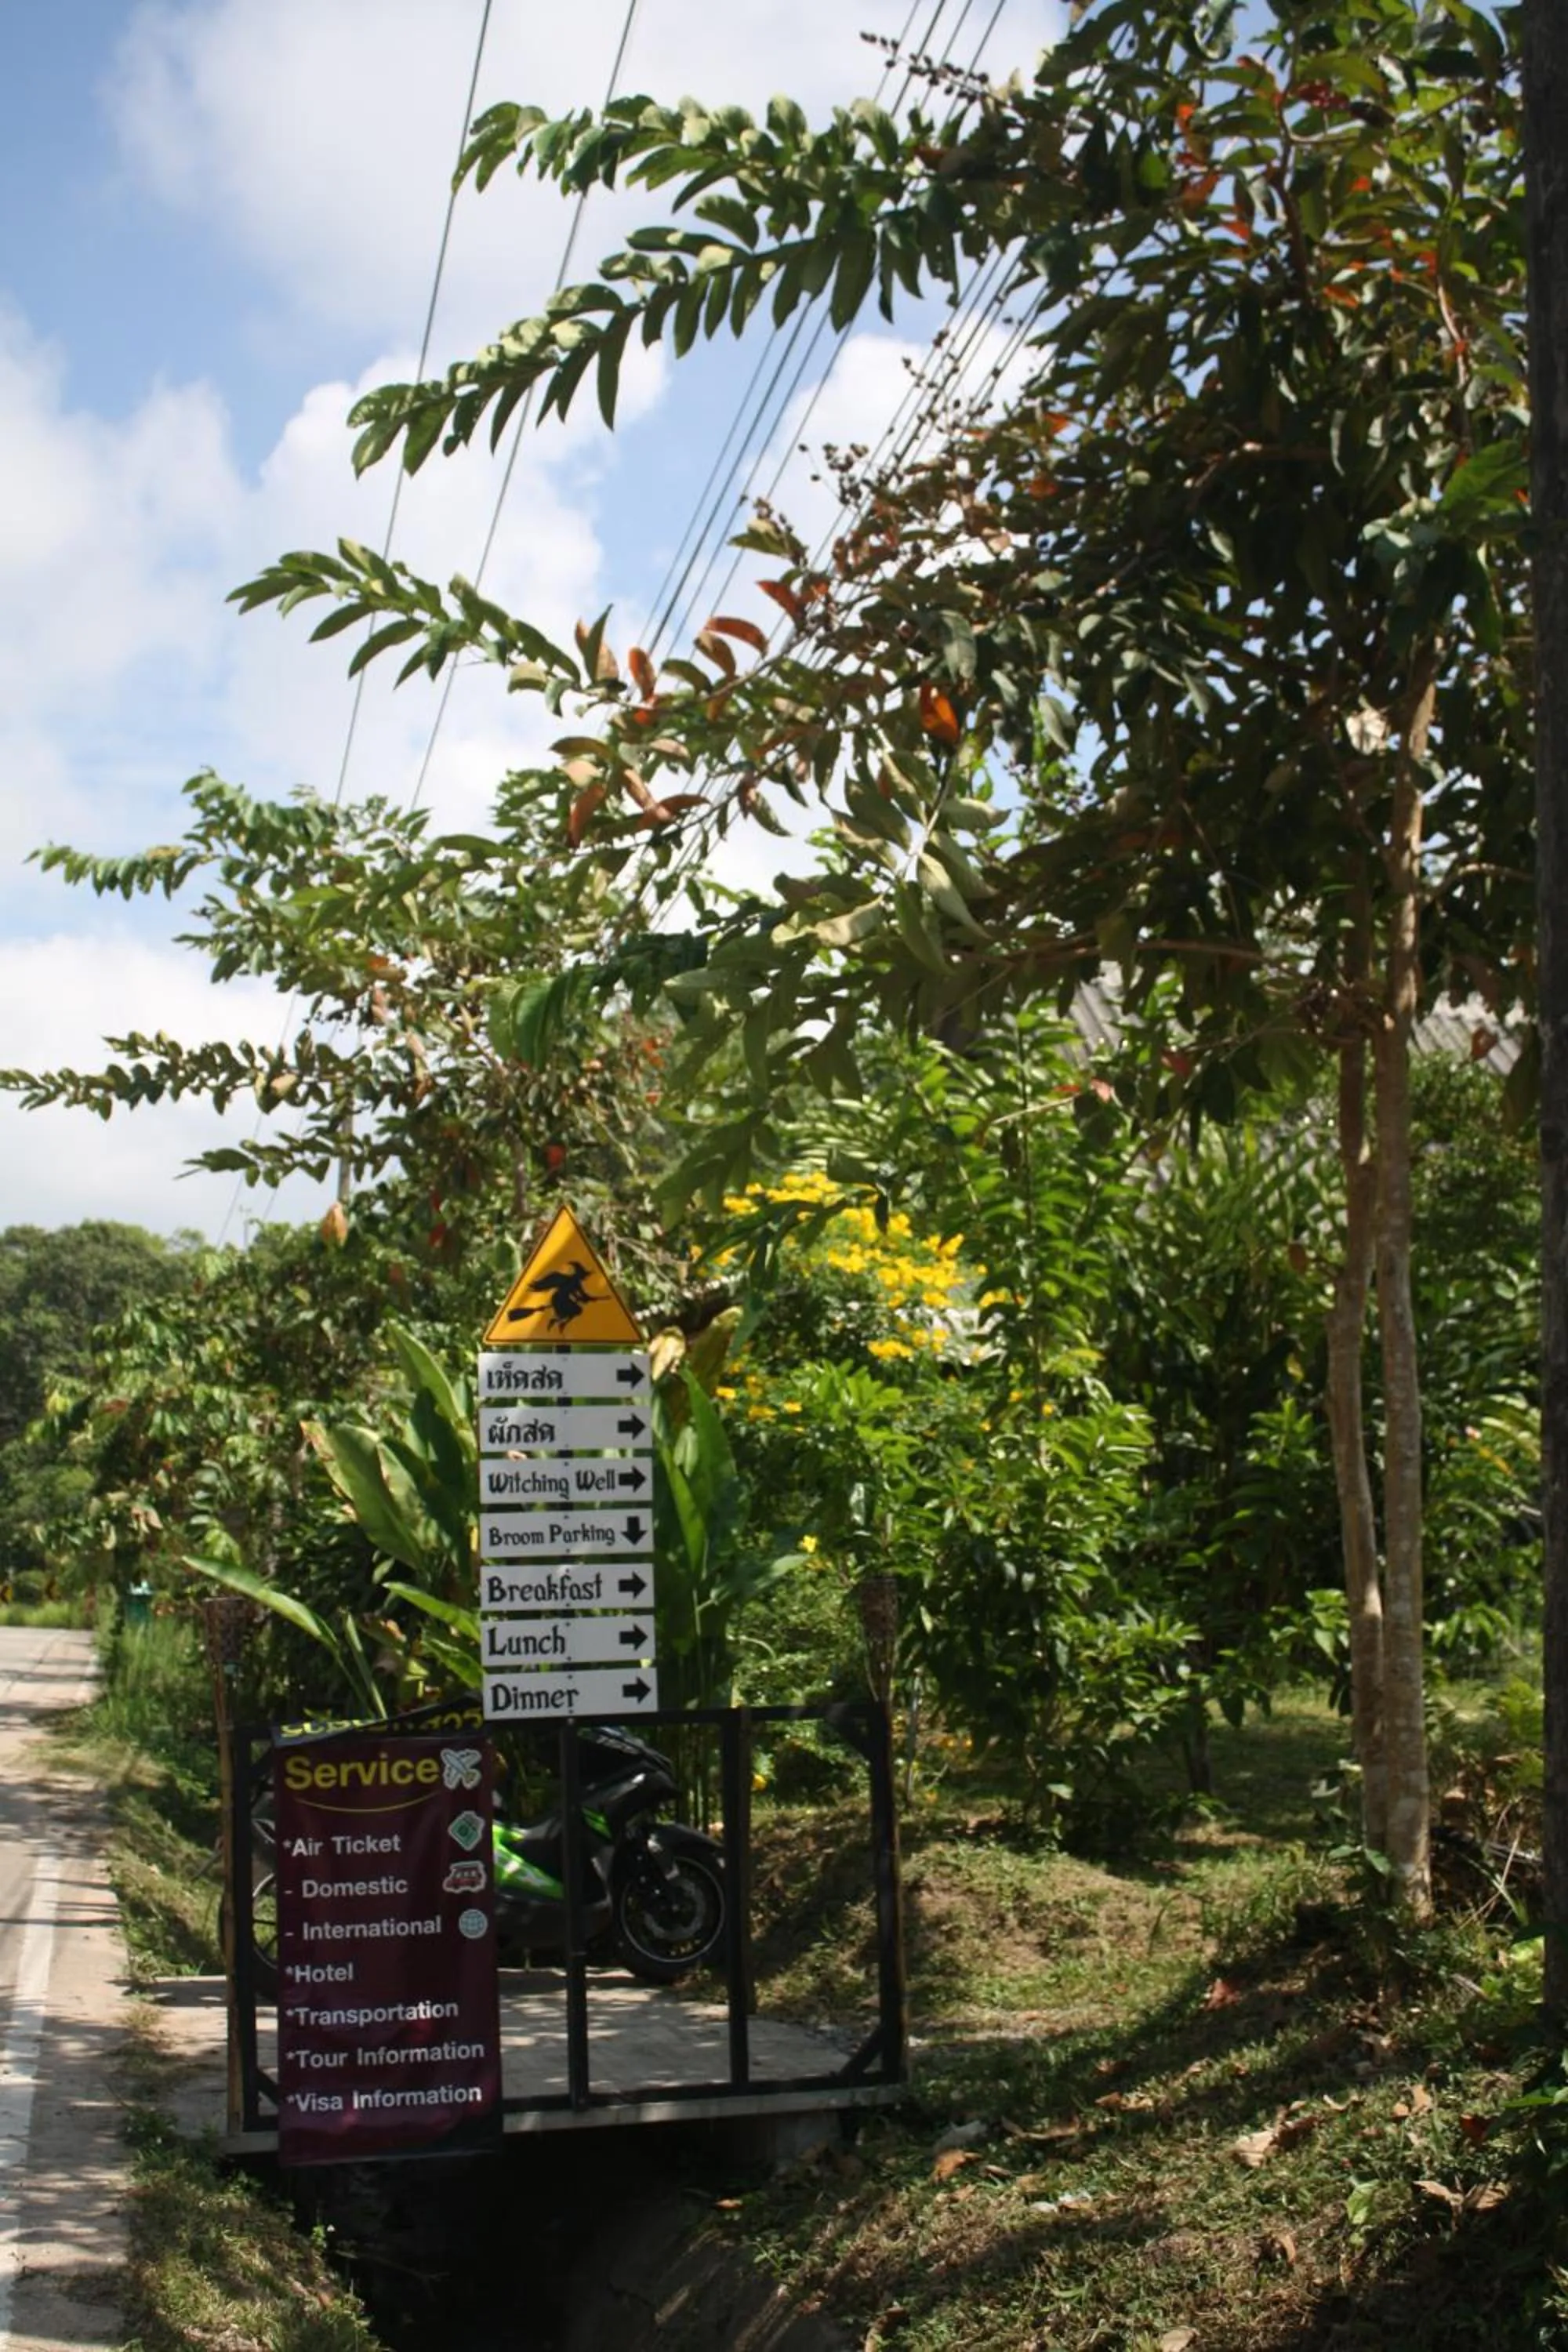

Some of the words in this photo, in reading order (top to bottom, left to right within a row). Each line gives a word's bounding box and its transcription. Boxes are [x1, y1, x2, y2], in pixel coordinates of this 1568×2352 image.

[488, 1472, 570, 1500] Witching
[575, 1469, 615, 1490] Well
[488, 1527, 545, 1546] Broom
[550, 1523, 615, 1546] Parking
[487, 1572, 602, 1603] Breakfast
[488, 1625, 565, 1656] Lunch
[491, 1683, 579, 1712] Dinner
[284, 1752, 439, 1790] Service
[332, 1834, 401, 1855] Ticket
[302, 1876, 408, 1898] Domestic
[303, 1915, 442, 1940] International
[357, 2041, 485, 2066] Information
[353, 2085, 482, 2109] Information
